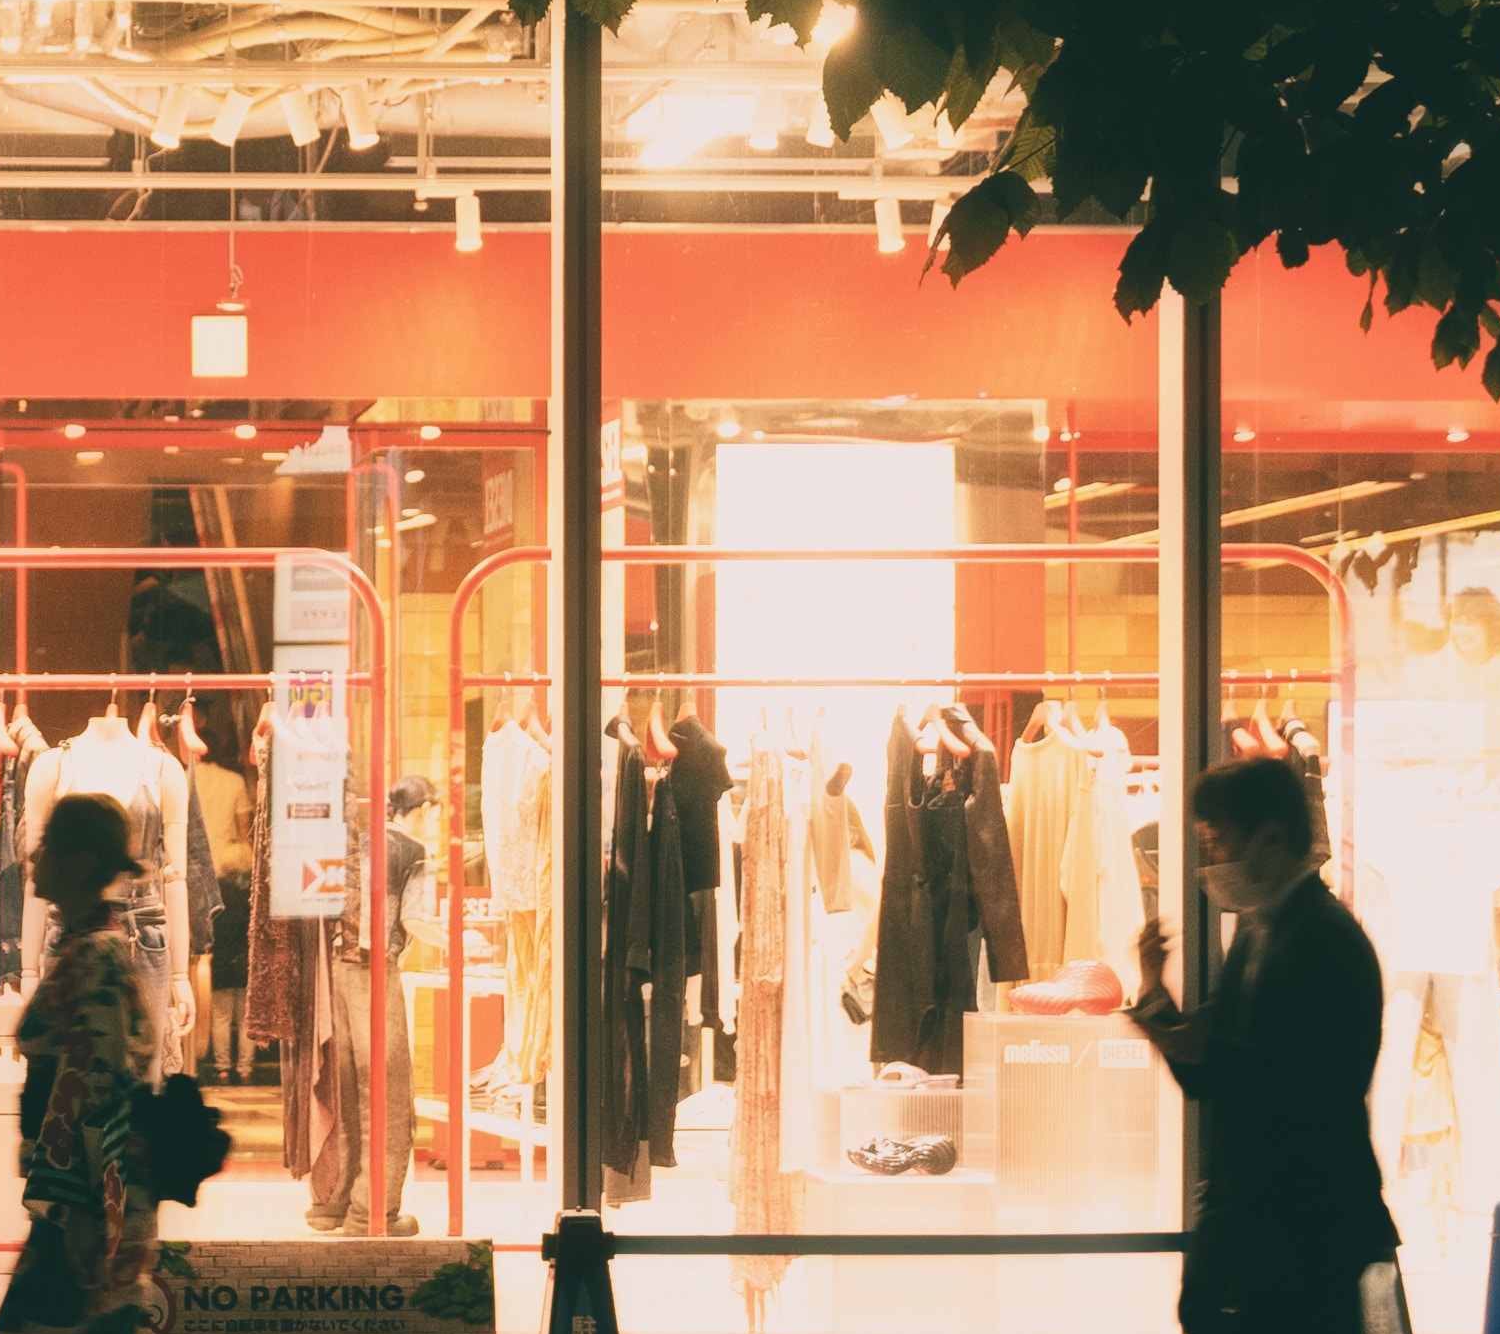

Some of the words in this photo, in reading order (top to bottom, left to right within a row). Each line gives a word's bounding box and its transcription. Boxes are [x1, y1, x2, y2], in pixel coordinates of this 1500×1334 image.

[1003, 1039, 1070, 1064] melissa
[1103, 1043, 1145, 1060] DIESEL
[183, 1285, 238, 1311] NO
[250, 1284, 405, 1312] PARKING
